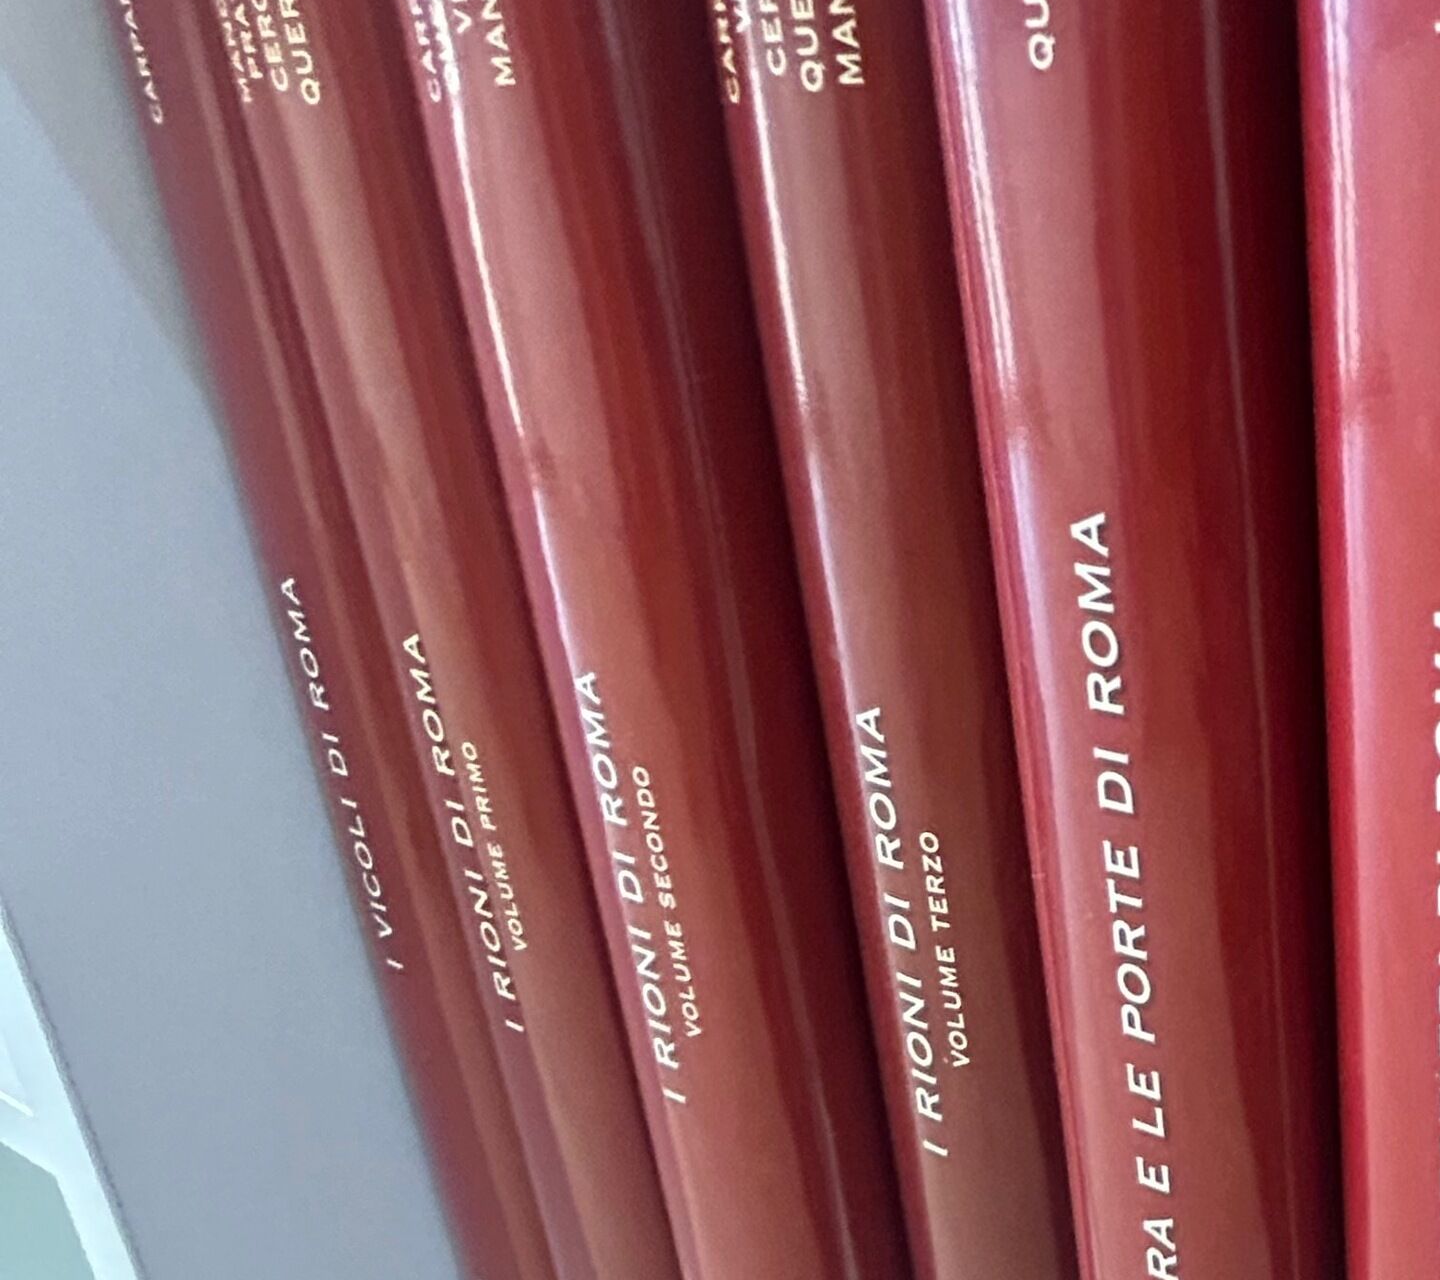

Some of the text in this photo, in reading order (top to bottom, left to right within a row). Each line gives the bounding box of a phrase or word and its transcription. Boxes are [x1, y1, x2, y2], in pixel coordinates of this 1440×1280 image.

[1070, 511, 1127, 716] ROMA
[281, 578, 404, 970] I VICOLI DI ROMA
[403, 633, 524, 1033] I RIONI DI ROMA
[461, 741, 528, 951] VOLUME PRIMO
[1092, 746, 1135, 815] DI
[574, 671, 686, 1104] I RIONI DI ROMA
[631, 765, 702, 1038] VOLUME SECONDO
[854, 707, 949, 1156] I RIONI DI ROMA
[917, 831, 971, 1068] VOLUME TERZO
[1103, 839, 1156, 1043] PORTE
[1125, 1063, 1165, 1139] LE
[1136, 1156, 1171, 1194] E
